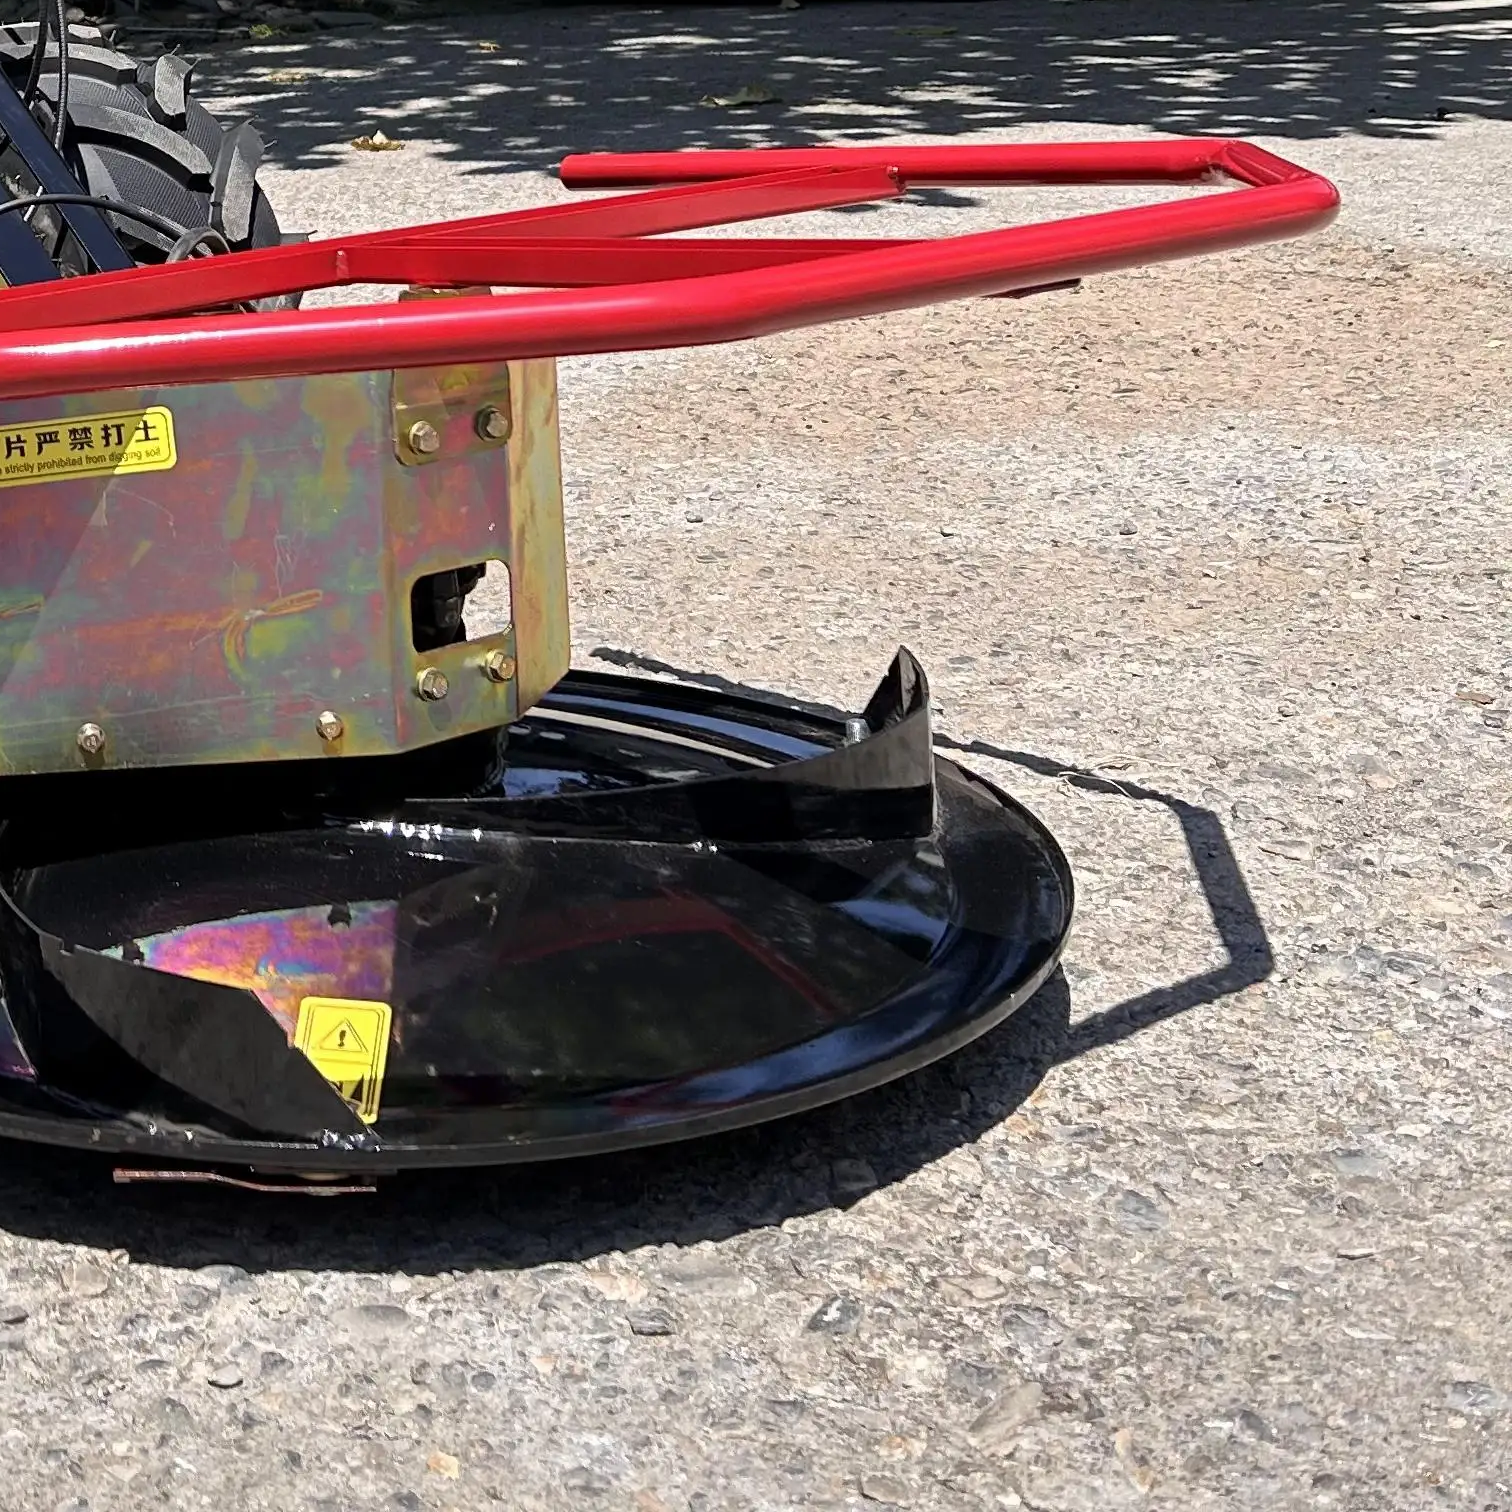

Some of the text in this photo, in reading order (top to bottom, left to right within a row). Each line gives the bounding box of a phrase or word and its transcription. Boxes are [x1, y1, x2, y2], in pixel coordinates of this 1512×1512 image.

[5, 462, 35, 473] strictly
[37, 455, 83, 472] prohibited
[85, 453, 106, 465] from
[109, 449, 142, 462] digging
[145, 445, 161, 457] soil
